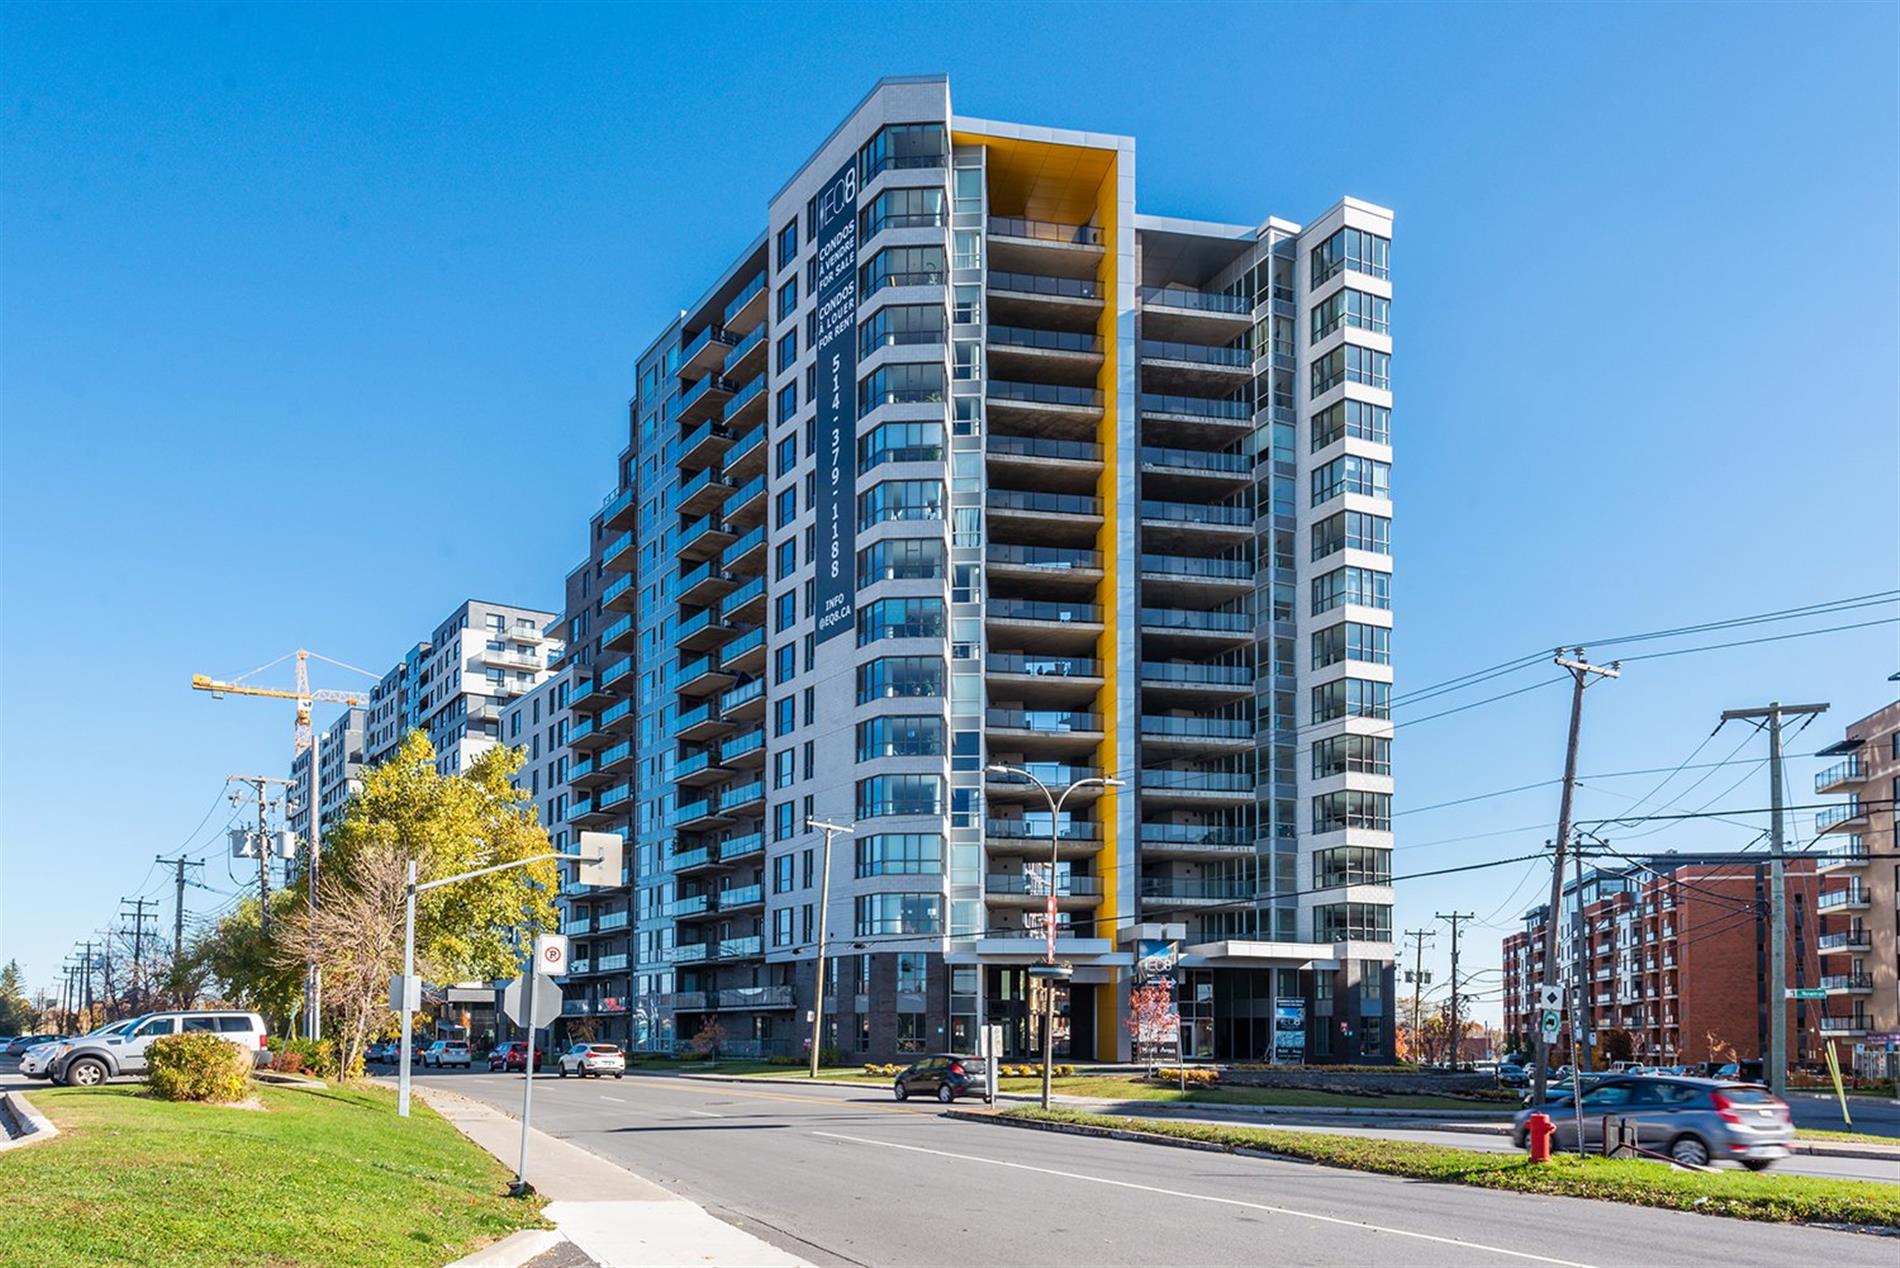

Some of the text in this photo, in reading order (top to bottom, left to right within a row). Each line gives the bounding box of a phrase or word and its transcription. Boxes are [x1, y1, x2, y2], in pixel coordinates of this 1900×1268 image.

[819, 219, 855, 261] CONDOS
[825, 235, 855, 270] VENDRE
[819, 251, 855, 292] FOR SALE
[819, 280, 855, 321] CONDOS
[827, 297, 855, 329] LOUER
[819, 312, 855, 350] FOR RENT
[818, 604, 851, 631] @EQ8.CA
[825, 592, 845, 612] INFO
